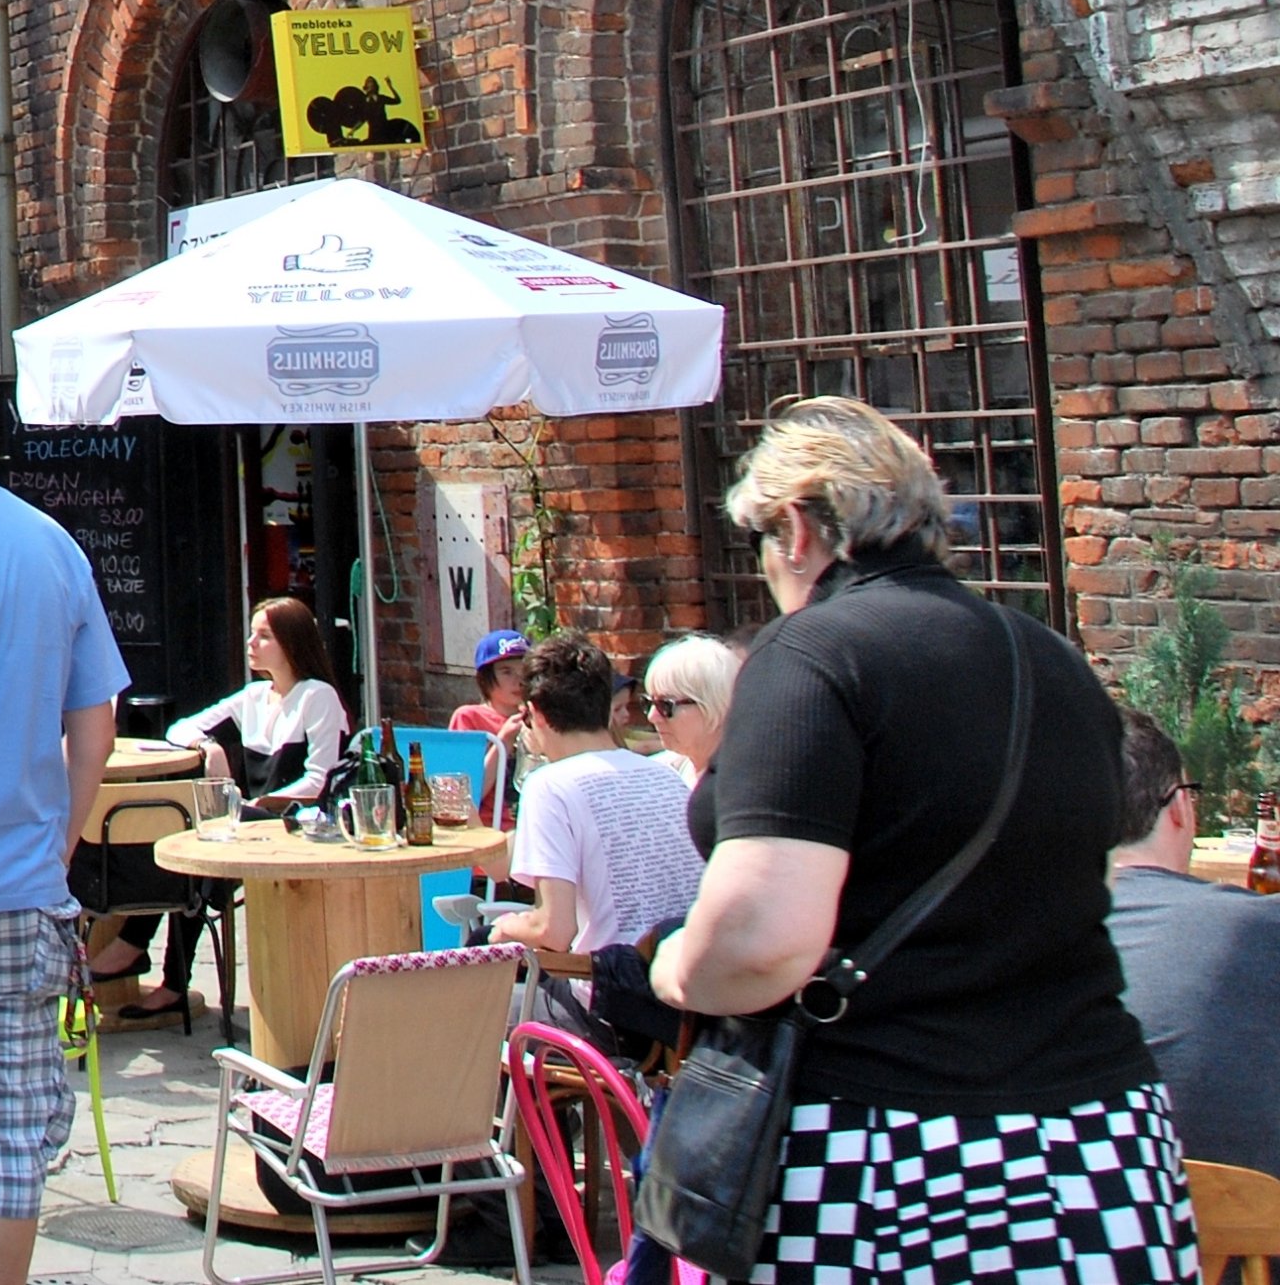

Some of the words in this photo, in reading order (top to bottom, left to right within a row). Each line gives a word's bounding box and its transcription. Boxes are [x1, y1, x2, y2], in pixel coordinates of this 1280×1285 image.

[291, 18, 352, 30] mebloteka
[293, 30, 404, 56] YELLOW
[248, 287, 412, 304] YELLOW
[24, 434, 137, 462] POLECAMY
[43, 487, 126, 508] SANGRIA
[448, 566, 473, 611] W
